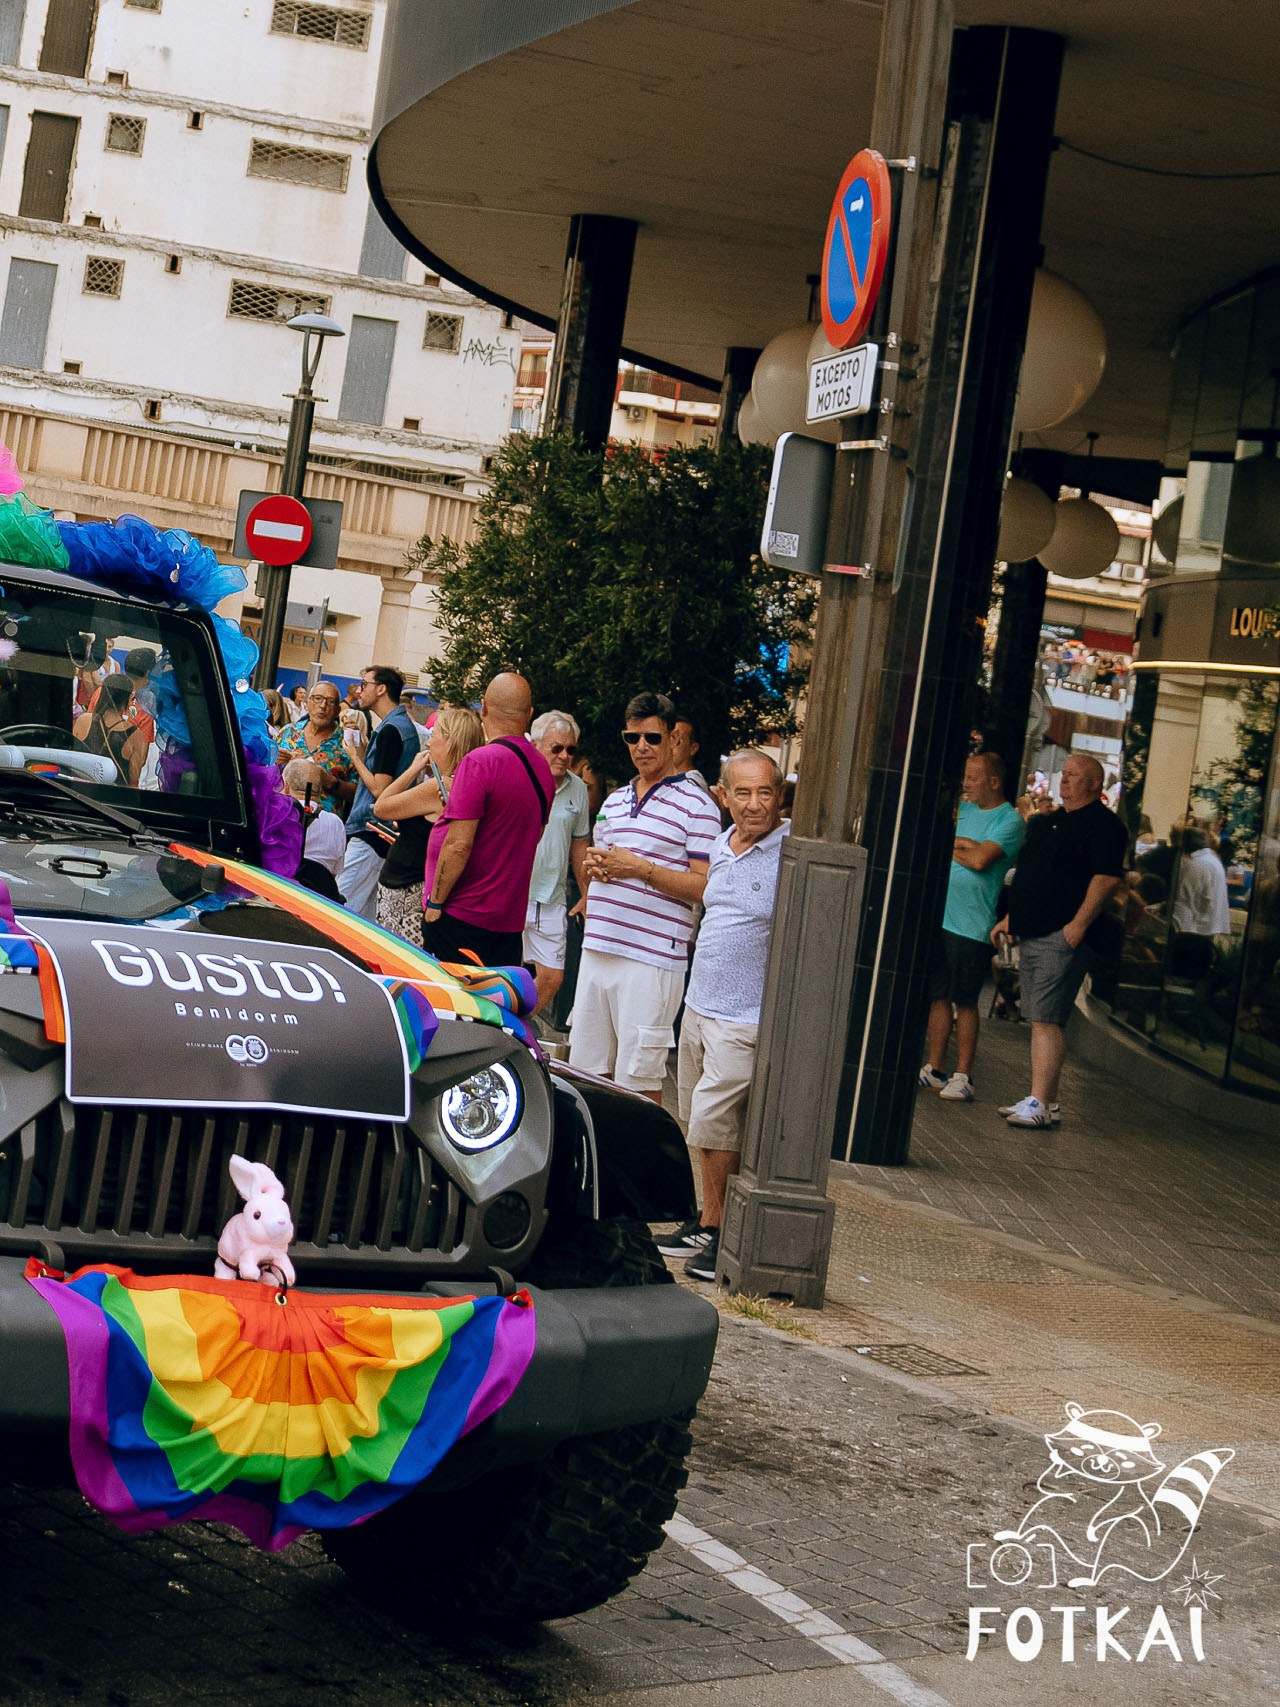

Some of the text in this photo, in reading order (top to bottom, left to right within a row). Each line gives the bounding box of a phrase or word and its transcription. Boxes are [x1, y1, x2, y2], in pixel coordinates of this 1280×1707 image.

[815, 357, 860, 388] EXCEPTO
[816, 385, 852, 413] MOTOS
[90, 939, 347, 1004] Gusto!
[174, 1002, 299, 1025] Benidorm
